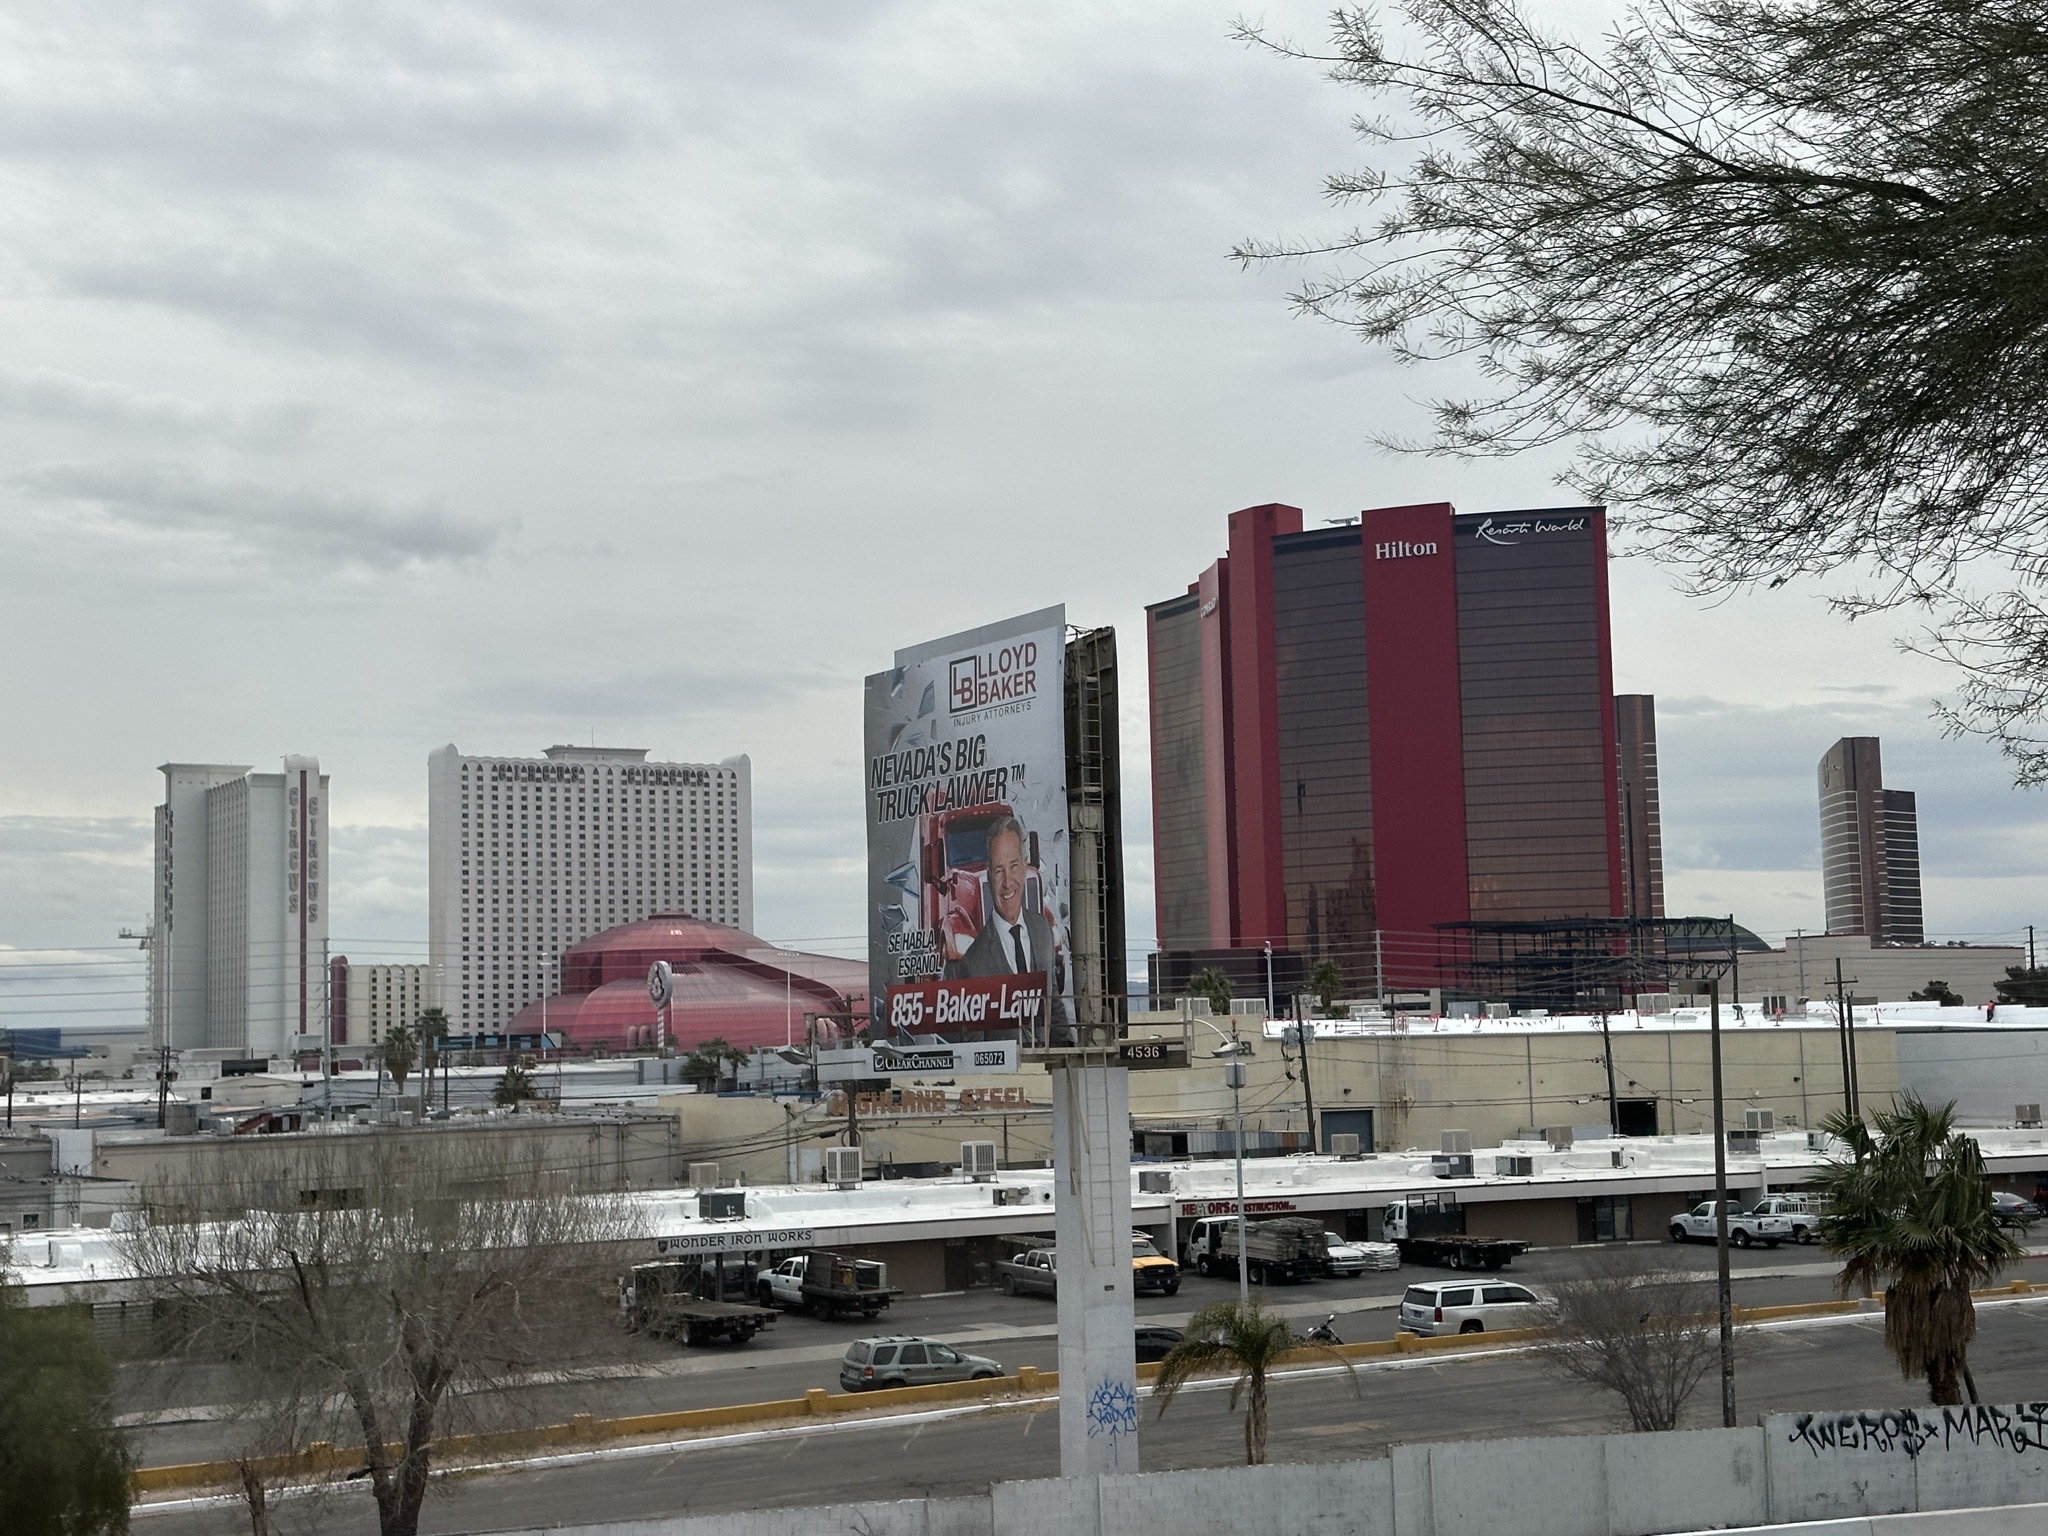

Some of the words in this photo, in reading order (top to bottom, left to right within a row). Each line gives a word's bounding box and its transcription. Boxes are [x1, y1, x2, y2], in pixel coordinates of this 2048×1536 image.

[1475, 518, 1531, 545] Resorts
[1535, 518, 1584, 533] World
[1375, 540, 1438, 560] Hilton
[978, 642, 1037, 679] LLOYD
[978, 669, 1037, 706] BAKER
[953, 713, 981, 727] INJURY
[983, 701, 1032, 721] ATTORNEYS
[871, 740, 953, 789] NEVADA'S
[955, 734, 986, 771] BIG
[498, 764, 579, 784] CIRCUS
[627, 766, 705, 787] CIRCUS
[876, 781, 935, 824] TRUCK
[888, 935, 902, 954] SE
[902, 928, 935, 951] HABLA
[898, 953, 942, 978] ESPAÑOL
[975, 1052, 1003, 1065] 065072
[1127, 1046, 1160, 1058] 4536
[959, 1087, 1032, 1111] STEEL
[670, 1235, 726, 1249] WONDER
[731, 1232, 762, 1246] IRON
[768, 1230, 812, 1243] WORKS
